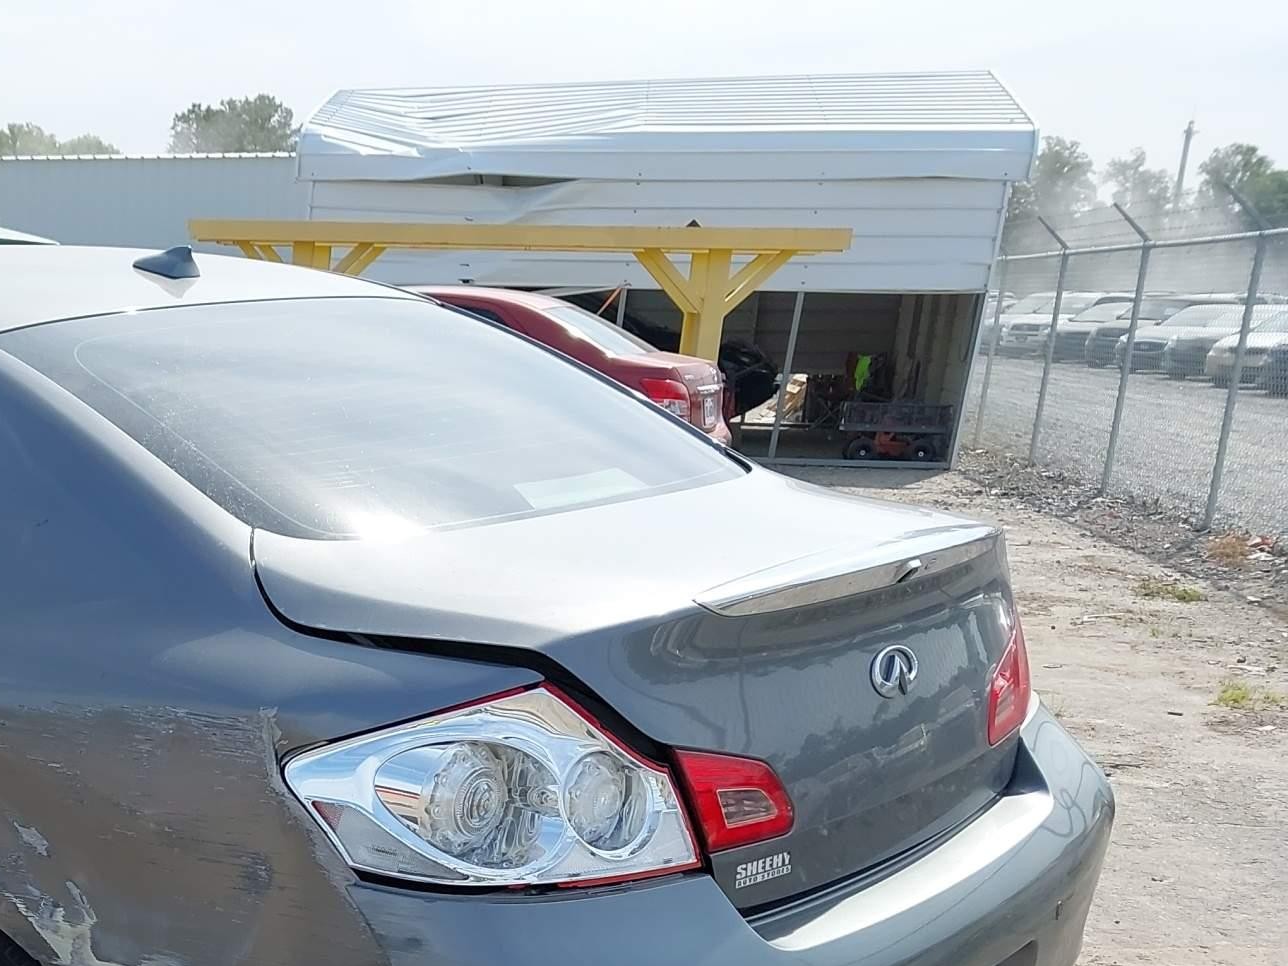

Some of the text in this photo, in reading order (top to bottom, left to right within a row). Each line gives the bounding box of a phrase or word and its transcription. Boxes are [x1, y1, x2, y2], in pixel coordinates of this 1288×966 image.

[736, 852, 790, 879] SHEEHY
[736, 865, 792, 888] AUTO STORES
